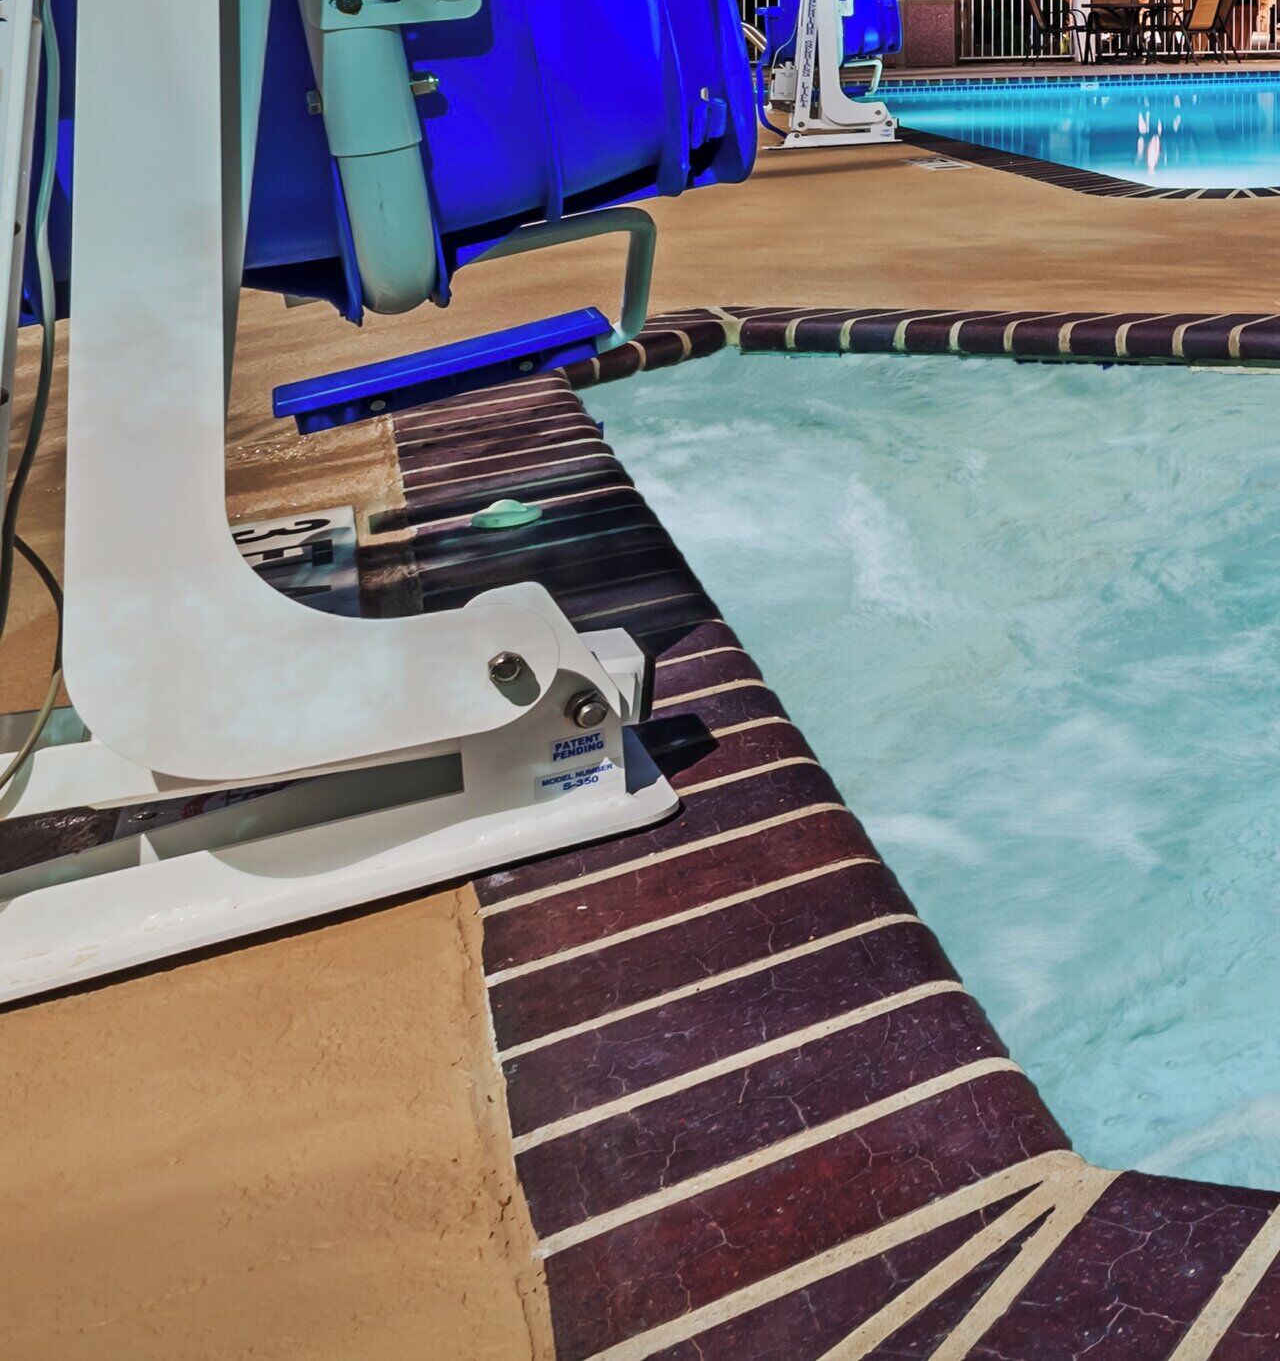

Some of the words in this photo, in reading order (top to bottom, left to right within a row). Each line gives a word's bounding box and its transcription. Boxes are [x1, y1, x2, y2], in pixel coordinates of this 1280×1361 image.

[552, 740, 604, 761] PENDING
[555, 732, 601, 751] PATENT
[541, 774, 573, 787] MODEL
[575, 763, 613, 778] NUMBER
[562, 775, 599, 791] S-350
